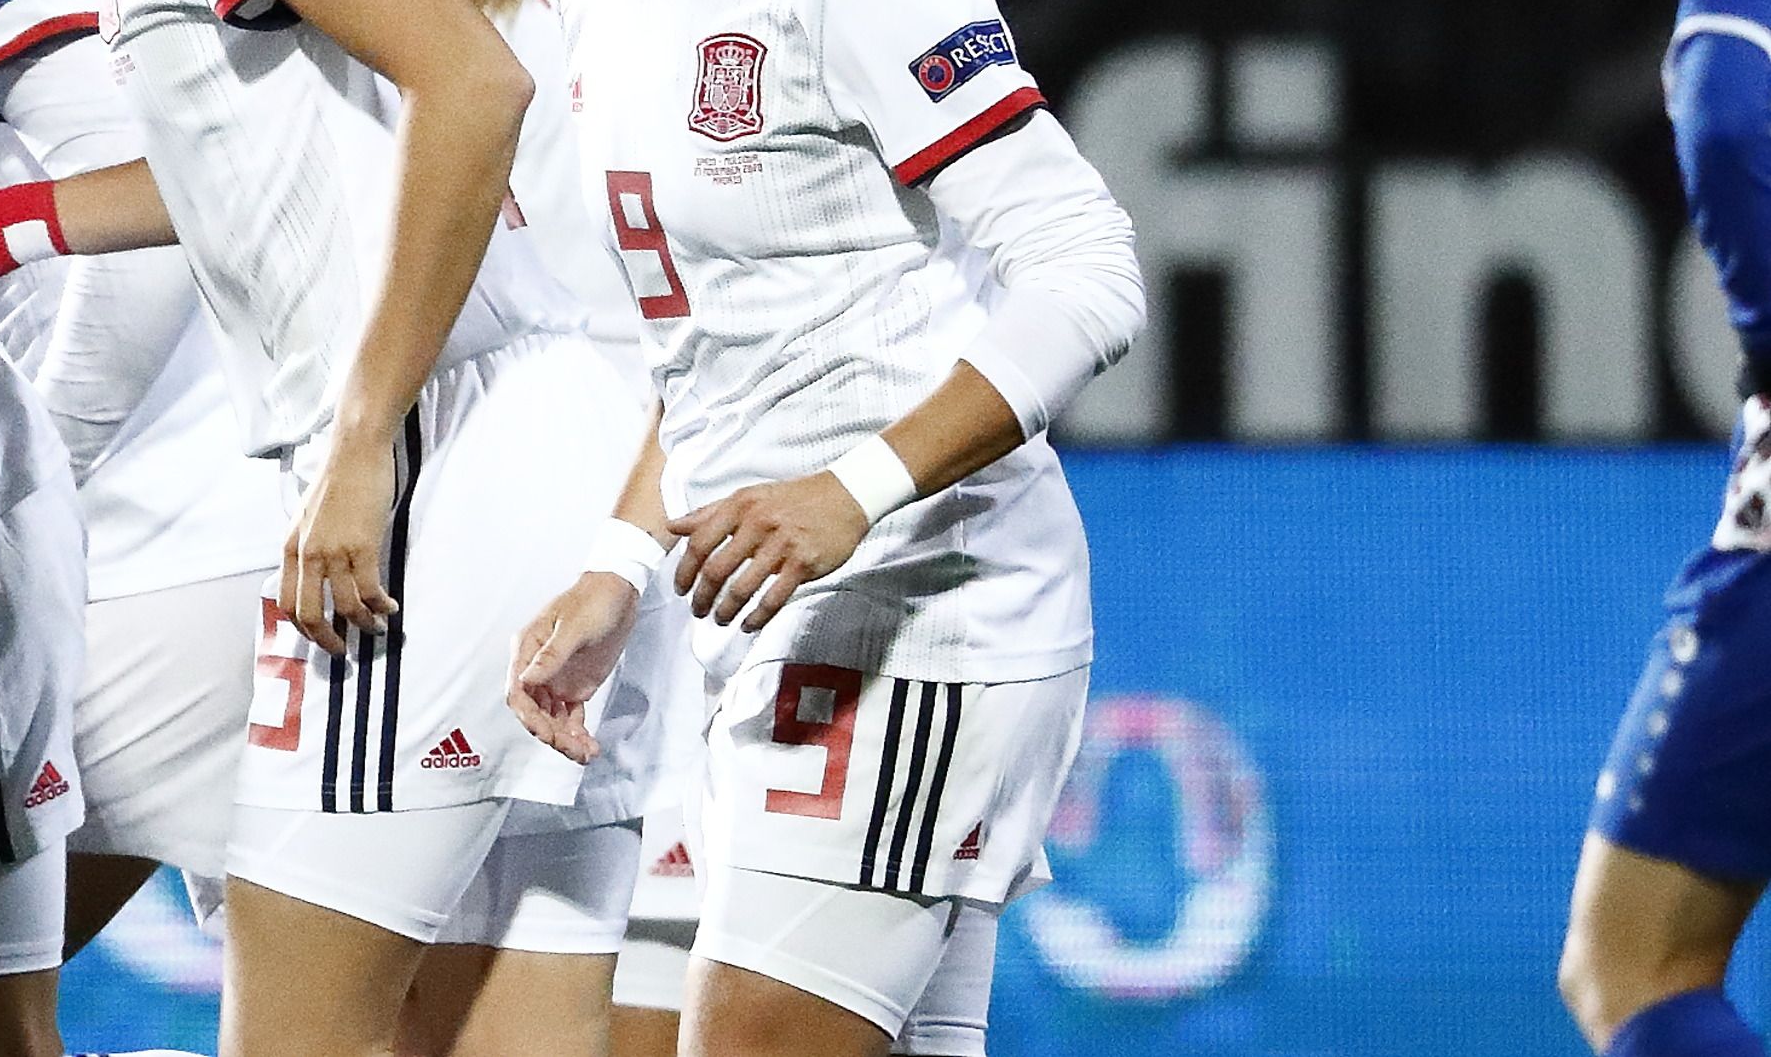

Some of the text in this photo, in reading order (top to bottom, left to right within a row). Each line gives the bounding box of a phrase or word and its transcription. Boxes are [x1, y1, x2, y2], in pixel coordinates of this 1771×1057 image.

[605, 170, 691, 320] 9
[24, 780, 70, 809] adidas
[765, 663, 863, 820] 9
